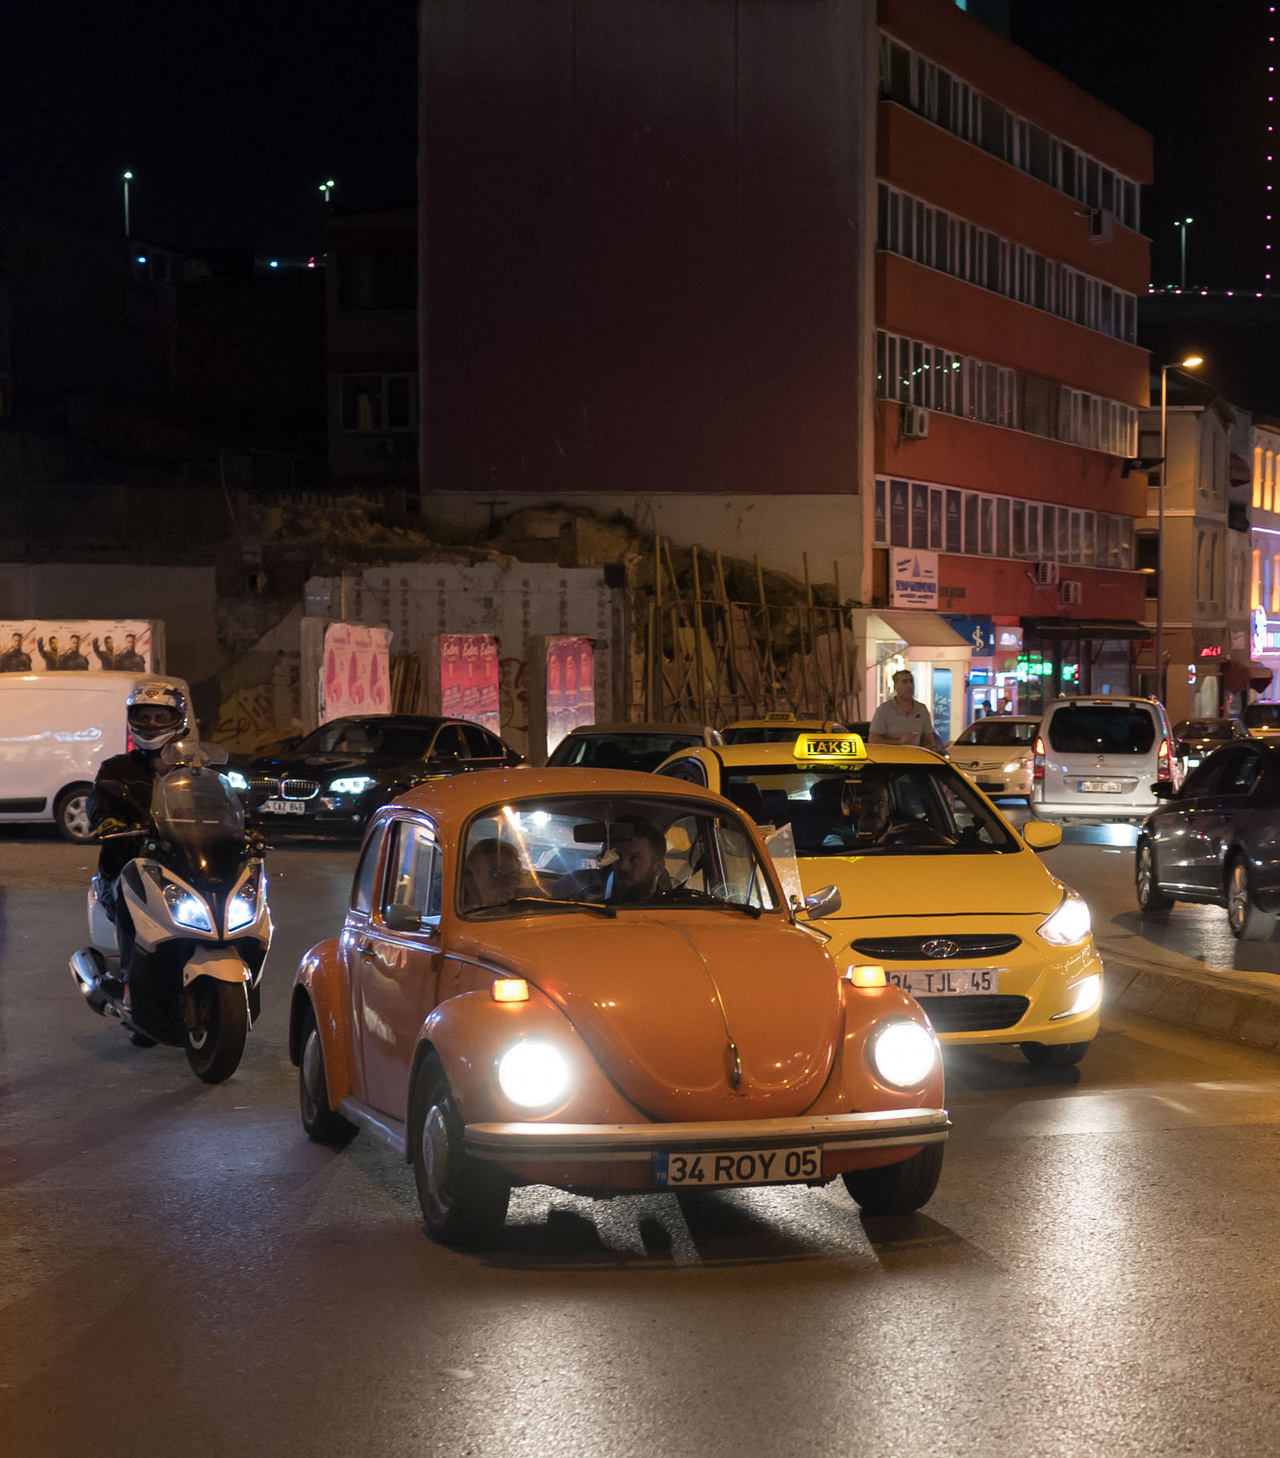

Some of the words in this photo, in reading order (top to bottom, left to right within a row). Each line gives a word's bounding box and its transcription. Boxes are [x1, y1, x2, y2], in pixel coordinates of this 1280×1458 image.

[891, 974, 912, 993] 34
[925, 973, 957, 993] TJL
[971, 972, 991, 991] 45
[671, 1157, 705, 1182] 34
[714, 1152, 776, 1181] ROY
[785, 1150, 817, 1177] 05
